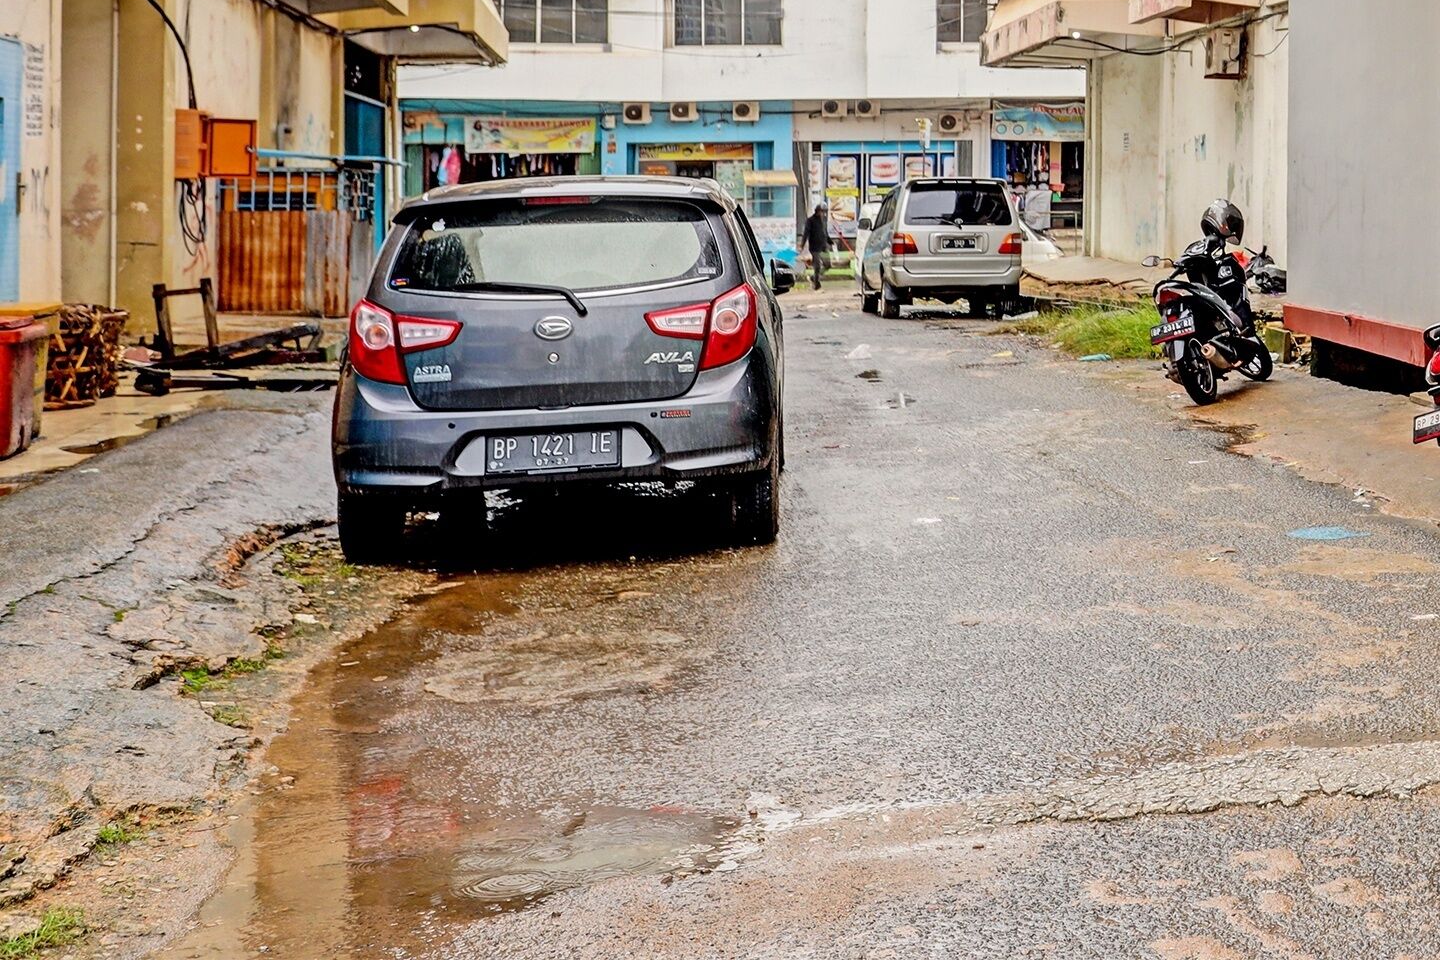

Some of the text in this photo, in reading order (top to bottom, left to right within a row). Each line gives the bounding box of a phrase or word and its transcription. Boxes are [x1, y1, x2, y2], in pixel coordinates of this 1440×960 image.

[643, 351, 695, 365] AYLA
[413, 365, 451, 376] ASTRA
[1416, 419, 1427, 430] BP
[493, 432, 611, 460] BP 1421 IE
